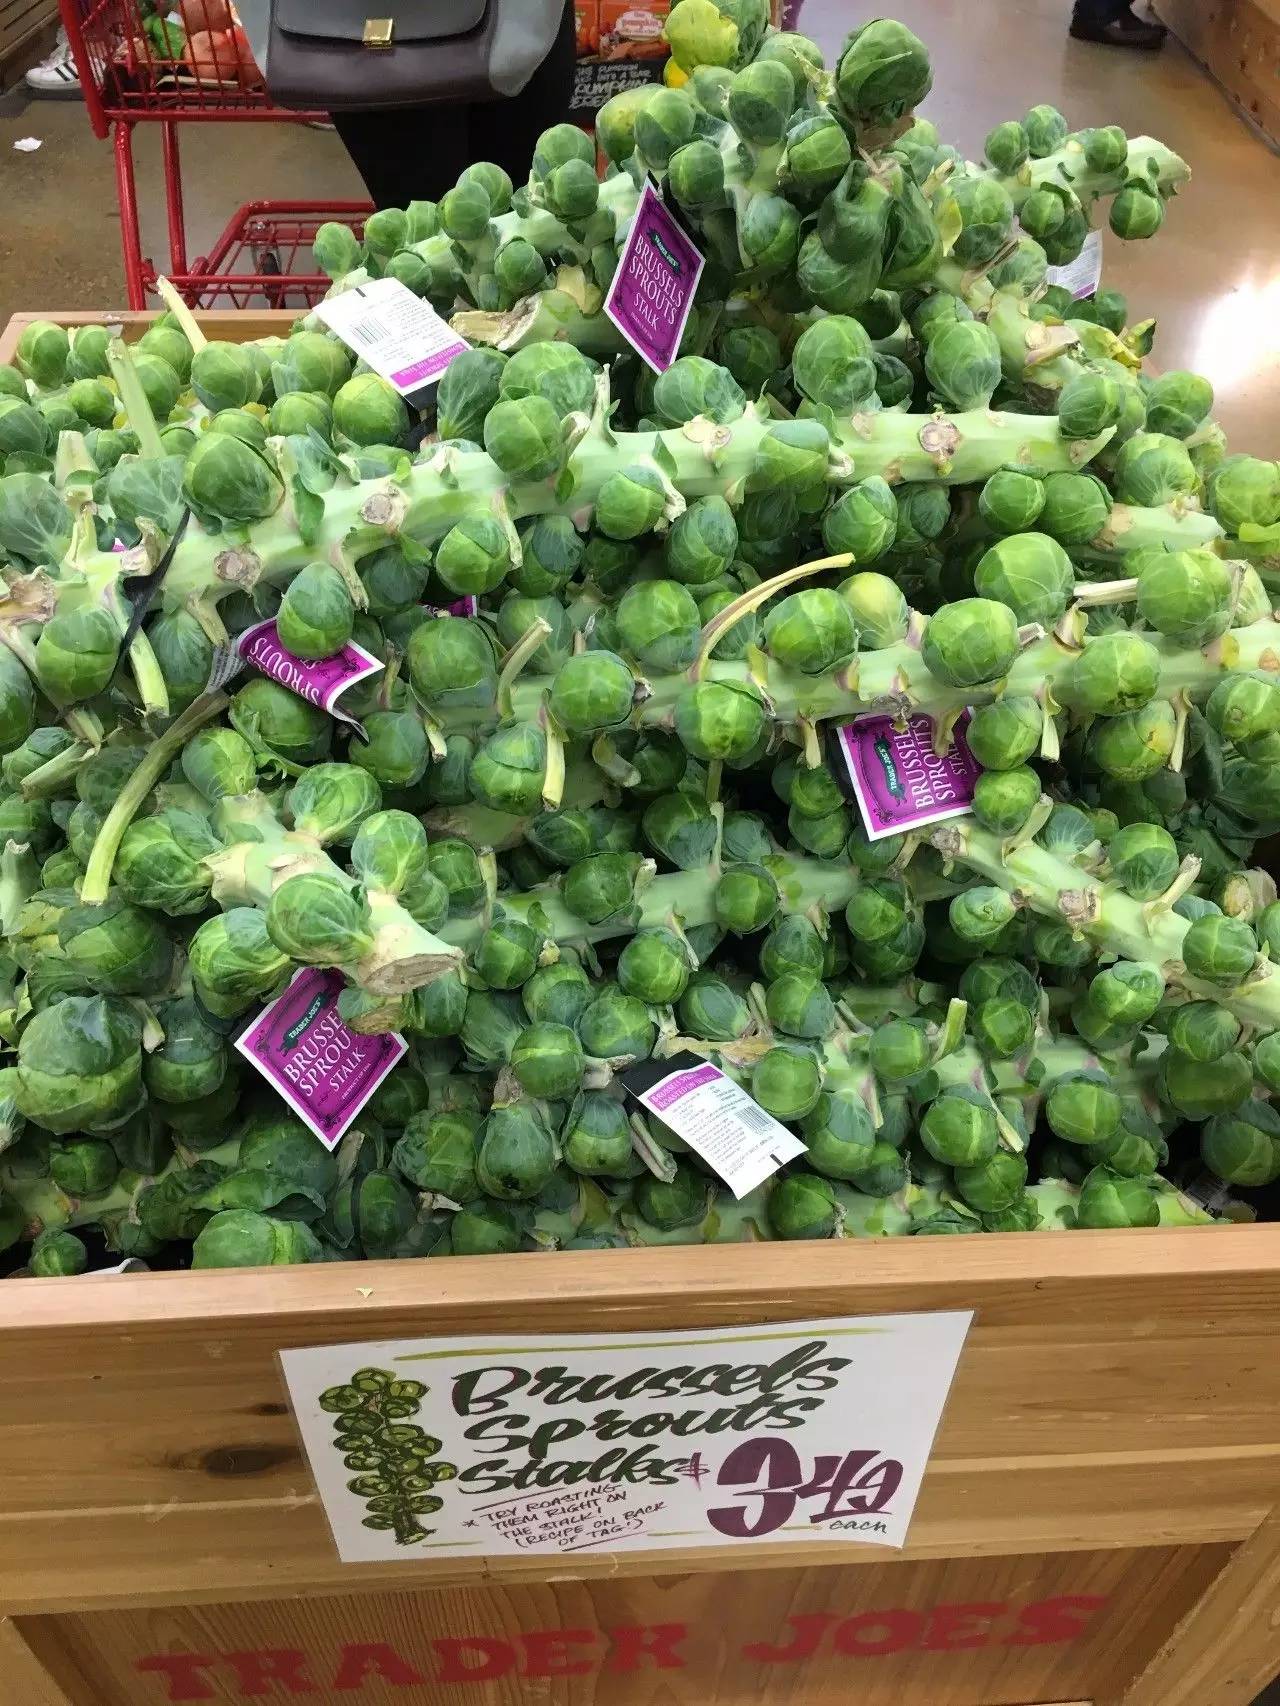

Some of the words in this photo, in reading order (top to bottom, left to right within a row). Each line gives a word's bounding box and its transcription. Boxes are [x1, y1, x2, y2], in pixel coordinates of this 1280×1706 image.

[629, 256, 677, 325] SPROUTS
[634, 233, 684, 308] BRUSSELS
[633, 292, 659, 331] STALK
[250, 637, 319, 706] SPROUTS
[948, 744, 967, 775] STAL
[283, 1006, 343, 1083] BRUSSE
[289, 1016, 311, 1039] TRADER
[299, 1026, 352, 1097] SPROU
[329, 1047, 366, 1092] STALK
[450, 1340, 853, 1417] Brussels
[463, 1392, 826, 1460] Sprouts
[458, 1443, 692, 1495] Stalks
[480, 1505, 517, 1522] TRY
[526, 1483, 622, 1513] ROASTING
[491, 1513, 538, 1531] THEM
[545, 1498, 604, 1519] RIGHT
[606, 1491, 627, 1503] ON
[500, 1526, 532, 1540] THE
[538, 1506, 603, 1530] STALK!
[515, 1525, 584, 1548] (RECIPE
[593, 1516, 616, 1529] ON
[623, 1501, 668, 1520] BACK
[558, 1534, 577, 1546] OF
[829, 1519, 889, 1534] each
[132, 1623, 690, 1701] TRADER
[741, 1594, 1109, 1665] JOES
